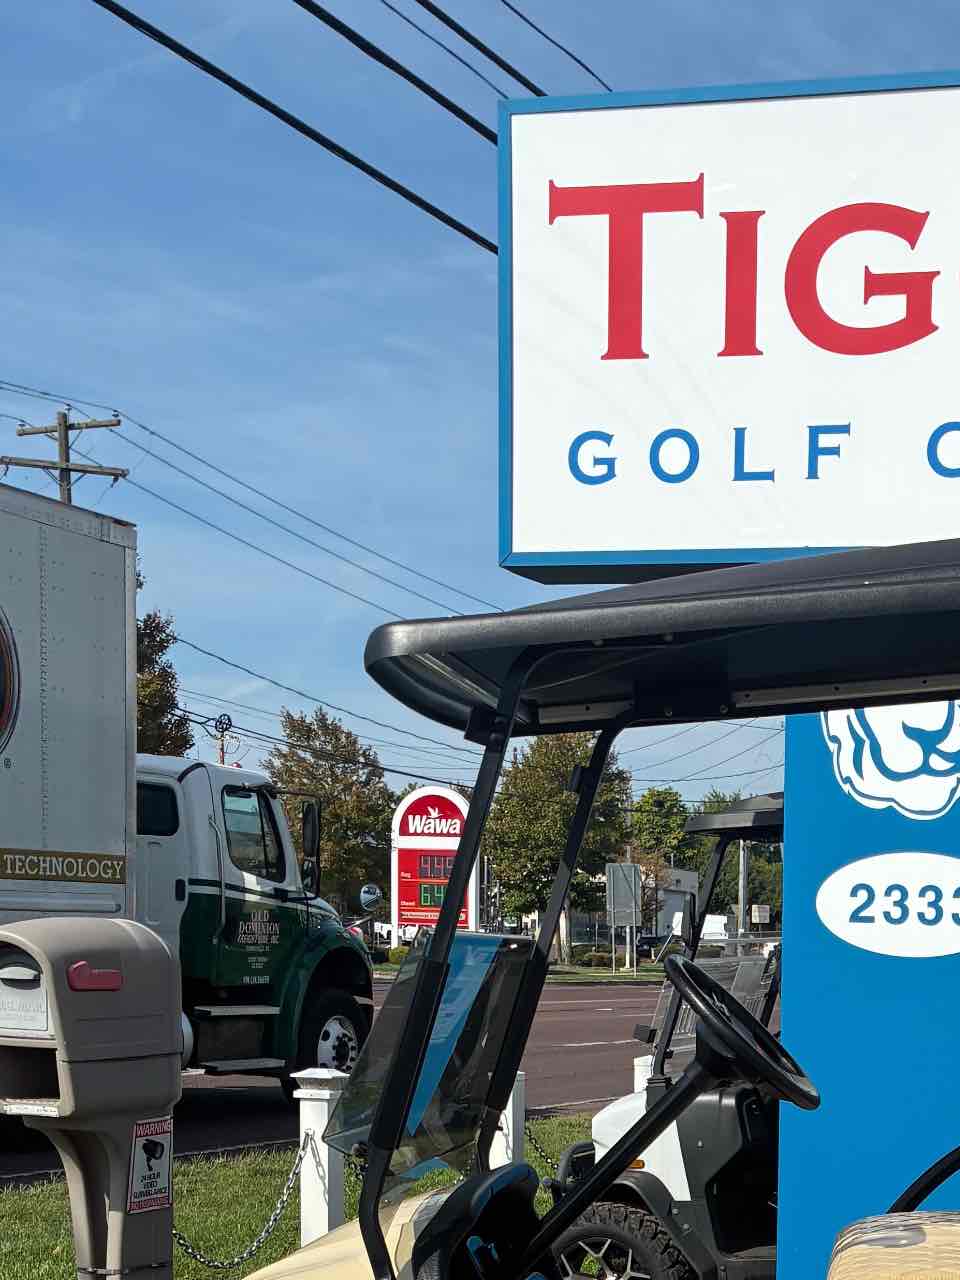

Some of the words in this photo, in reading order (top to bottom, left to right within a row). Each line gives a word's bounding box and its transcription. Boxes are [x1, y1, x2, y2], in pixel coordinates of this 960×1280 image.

[568, 424, 850, 486] GOLF
[407, 814, 461, 834] Wawa
[4, 854, 123, 879] TECHNOLOGY
[136, 1120, 171, 1136] WARNING
